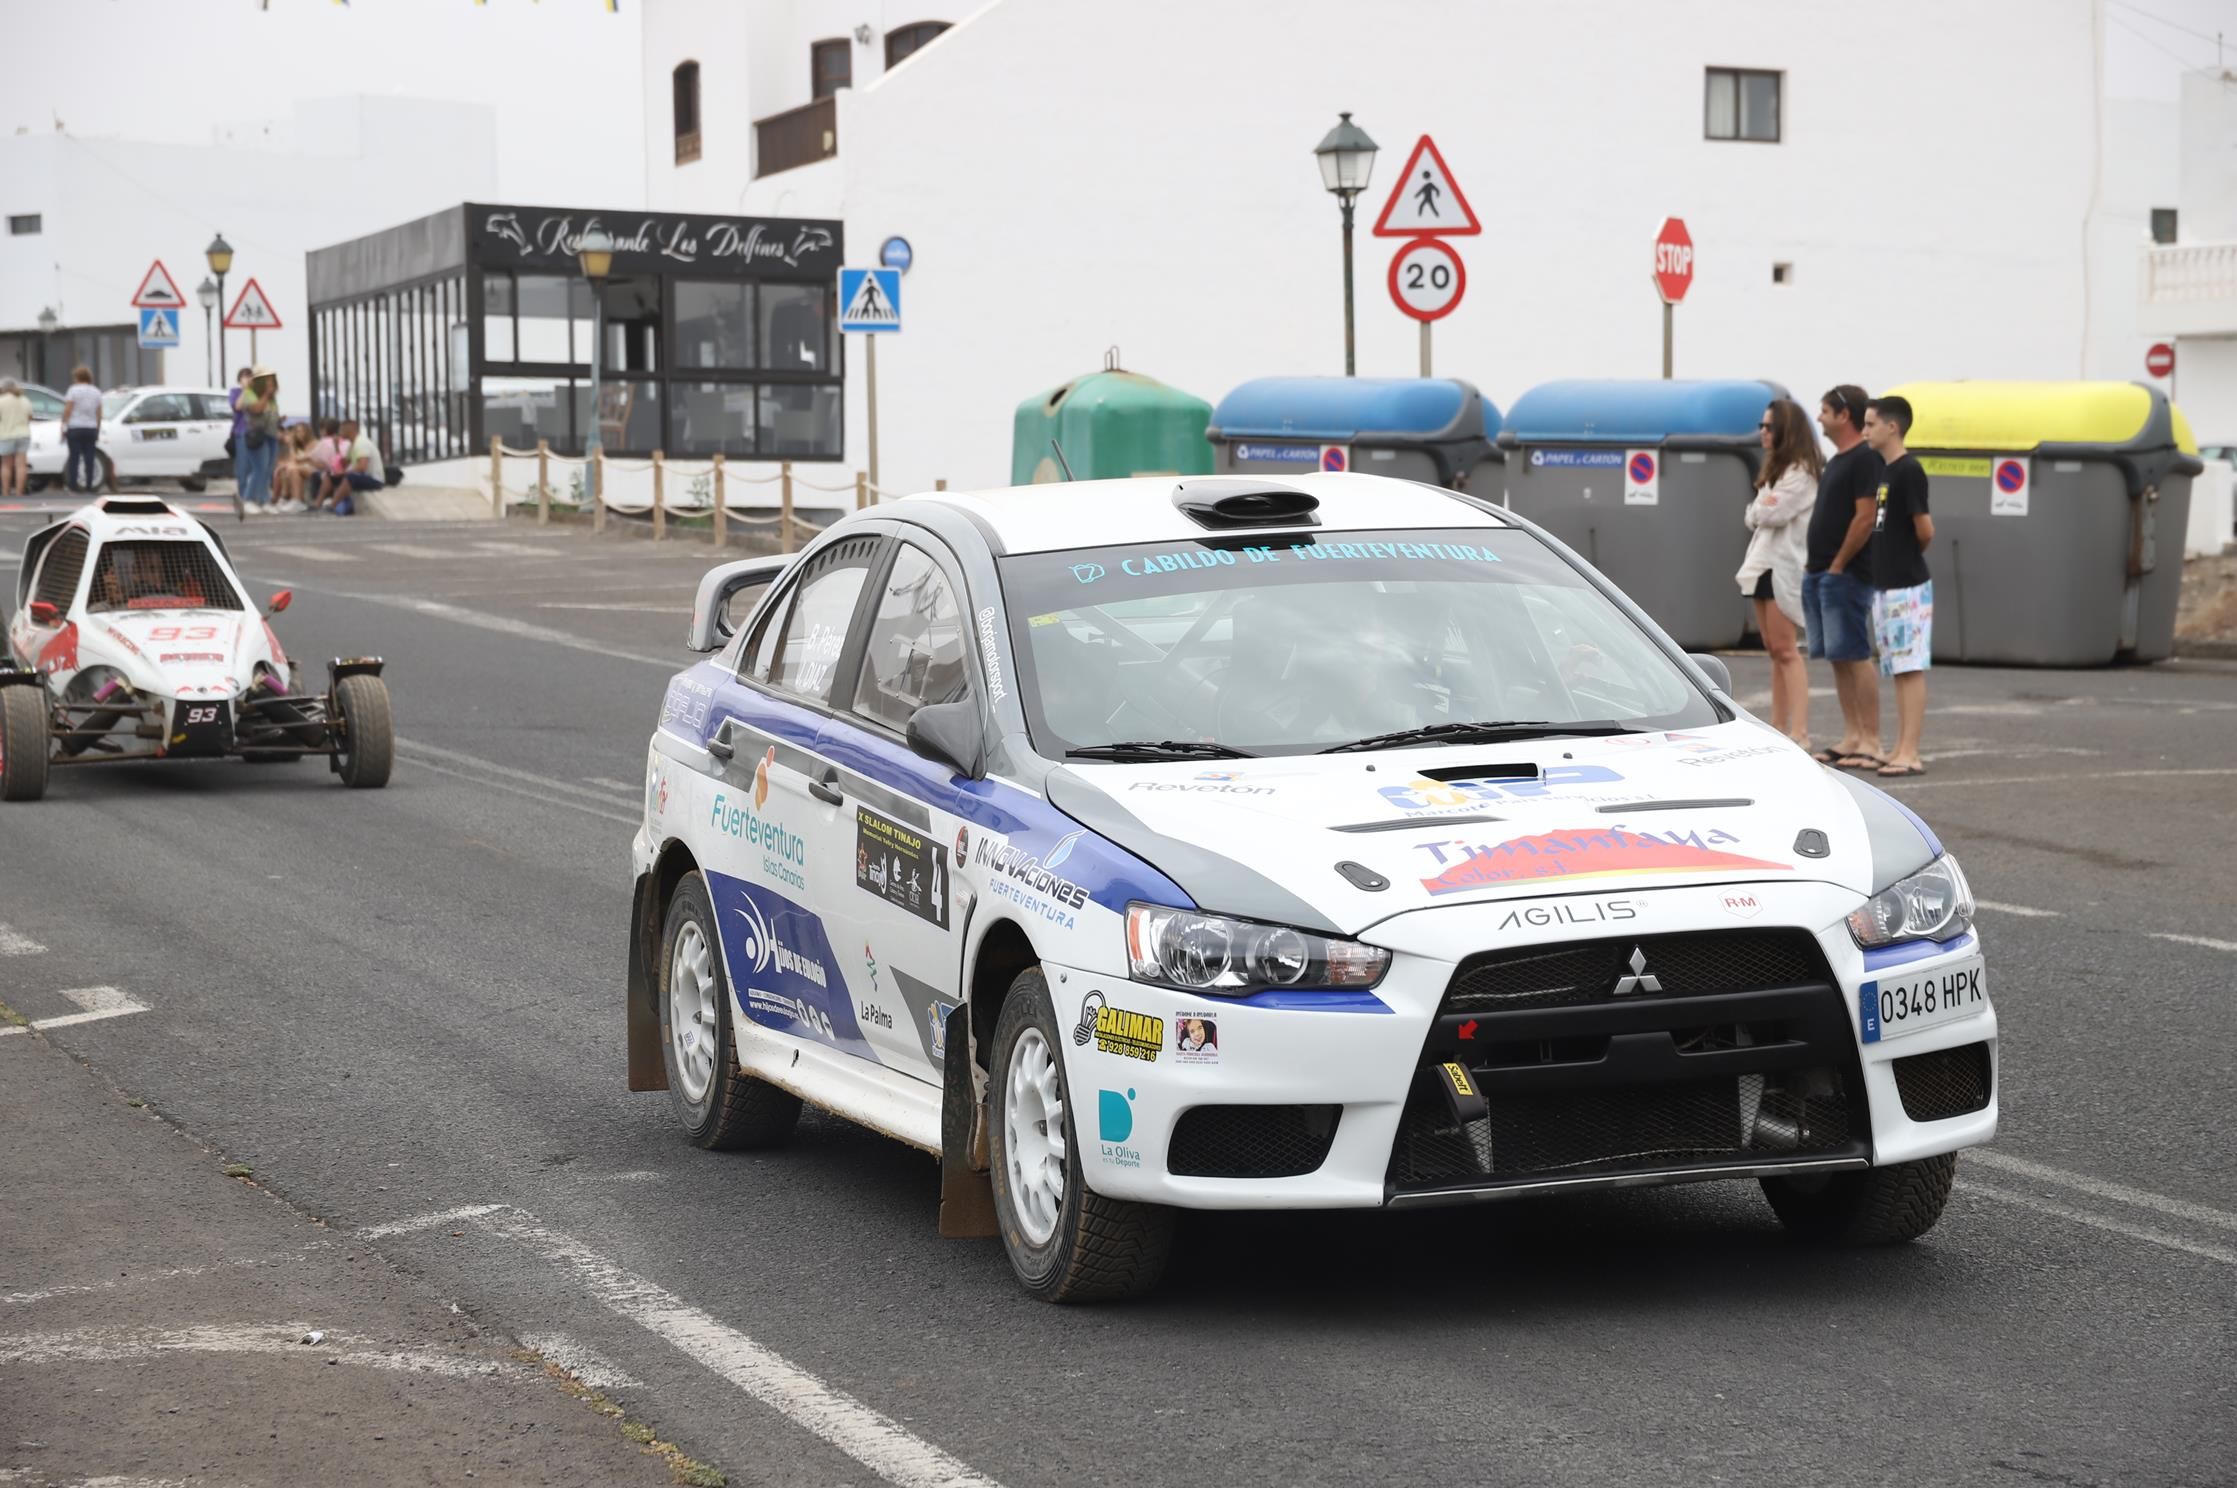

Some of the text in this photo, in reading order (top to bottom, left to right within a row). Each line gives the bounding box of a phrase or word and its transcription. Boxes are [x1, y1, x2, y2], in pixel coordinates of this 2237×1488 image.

[705, 222, 784, 264] Delfines
[1657, 243, 1692, 275] STOP
[1406, 264, 1450, 290] 20
[1546, 453, 1574, 464] PAPEL
[1122, 543, 1503, 576] CABILDO DE FUERTEVENTURA
[148, 627, 218, 641] 93
[187, 707, 217, 724] 93
[711, 793, 805, 866] Fuerteventura
[858, 811, 922, 850] X SLALOM TINAJO
[1413, 824, 1741, 865] Timanfaya
[778, 862, 805, 891] Canarias
[931, 846, 943, 922] 4
[990, 878, 1075, 930] FUERTEVENTURA
[1881, 967, 1982, 1023] 0348 HPK
[861, 1000, 893, 1030] La Palma
[1096, 1006, 1163, 1045] GALIMAR
[1867, 1018, 1875, 1031] E
[1109, 1041, 1157, 1062] 928 859 216
[1101, 1143, 1141, 1161] La Oliva
[1115, 1156, 1141, 1169] Deporte
